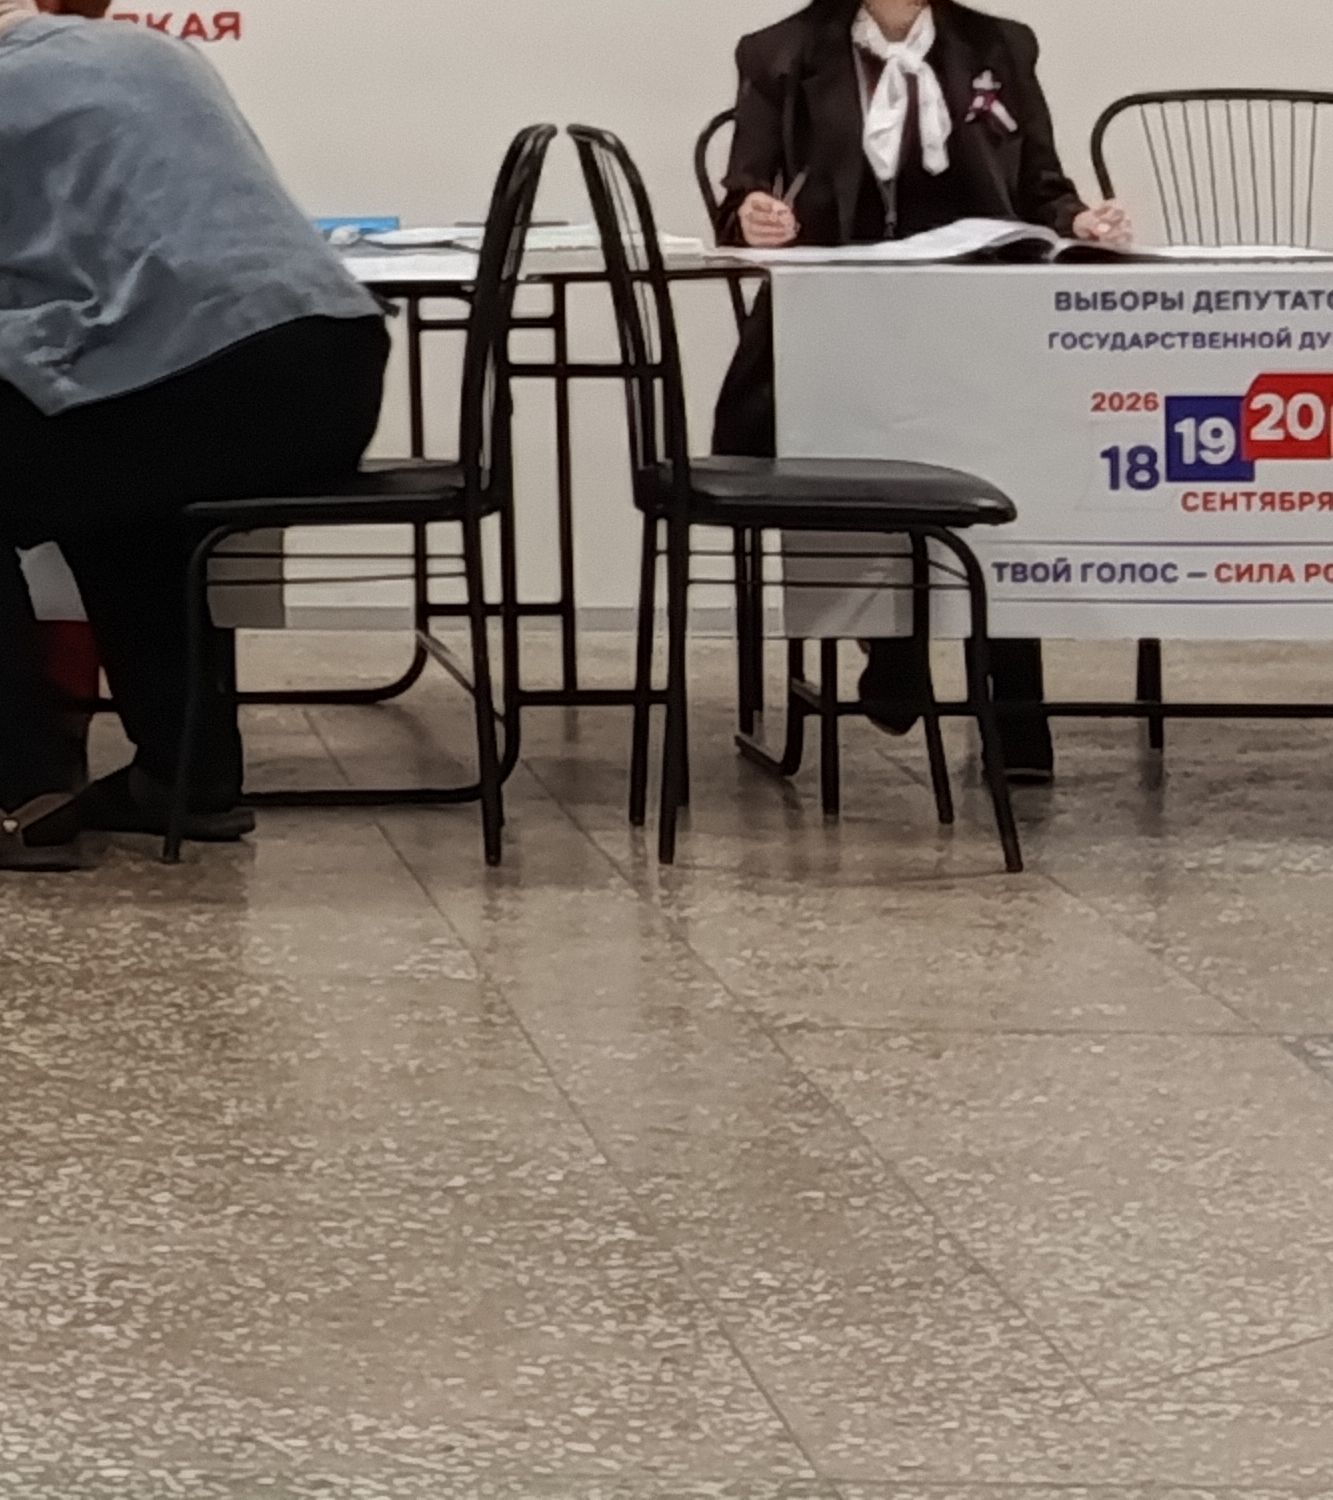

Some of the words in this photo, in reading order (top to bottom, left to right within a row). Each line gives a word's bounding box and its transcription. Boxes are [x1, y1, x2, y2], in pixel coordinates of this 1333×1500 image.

[1055, 291, 1184, 311] ВЫБОРЫ
[1192, 290, 1333, 314] ДЕПУТАТ
[1049, 327, 1292, 351] ГОСУДАРСТВЕННОЙ
[1091, 392, 1159, 412] 2026
[1101, 445, 1160, 490] 18
[1174, 417, 1236, 465] 19
[1249, 392, 1325, 441] 20
[1181, 491, 1333, 513] СЕНТЯБРЯ
[992, 558, 1071, 583] ТВОЙ
[1081, 562, 1178, 583] ГОЛОС
[1215, 563, 1295, 583] СИЛА
